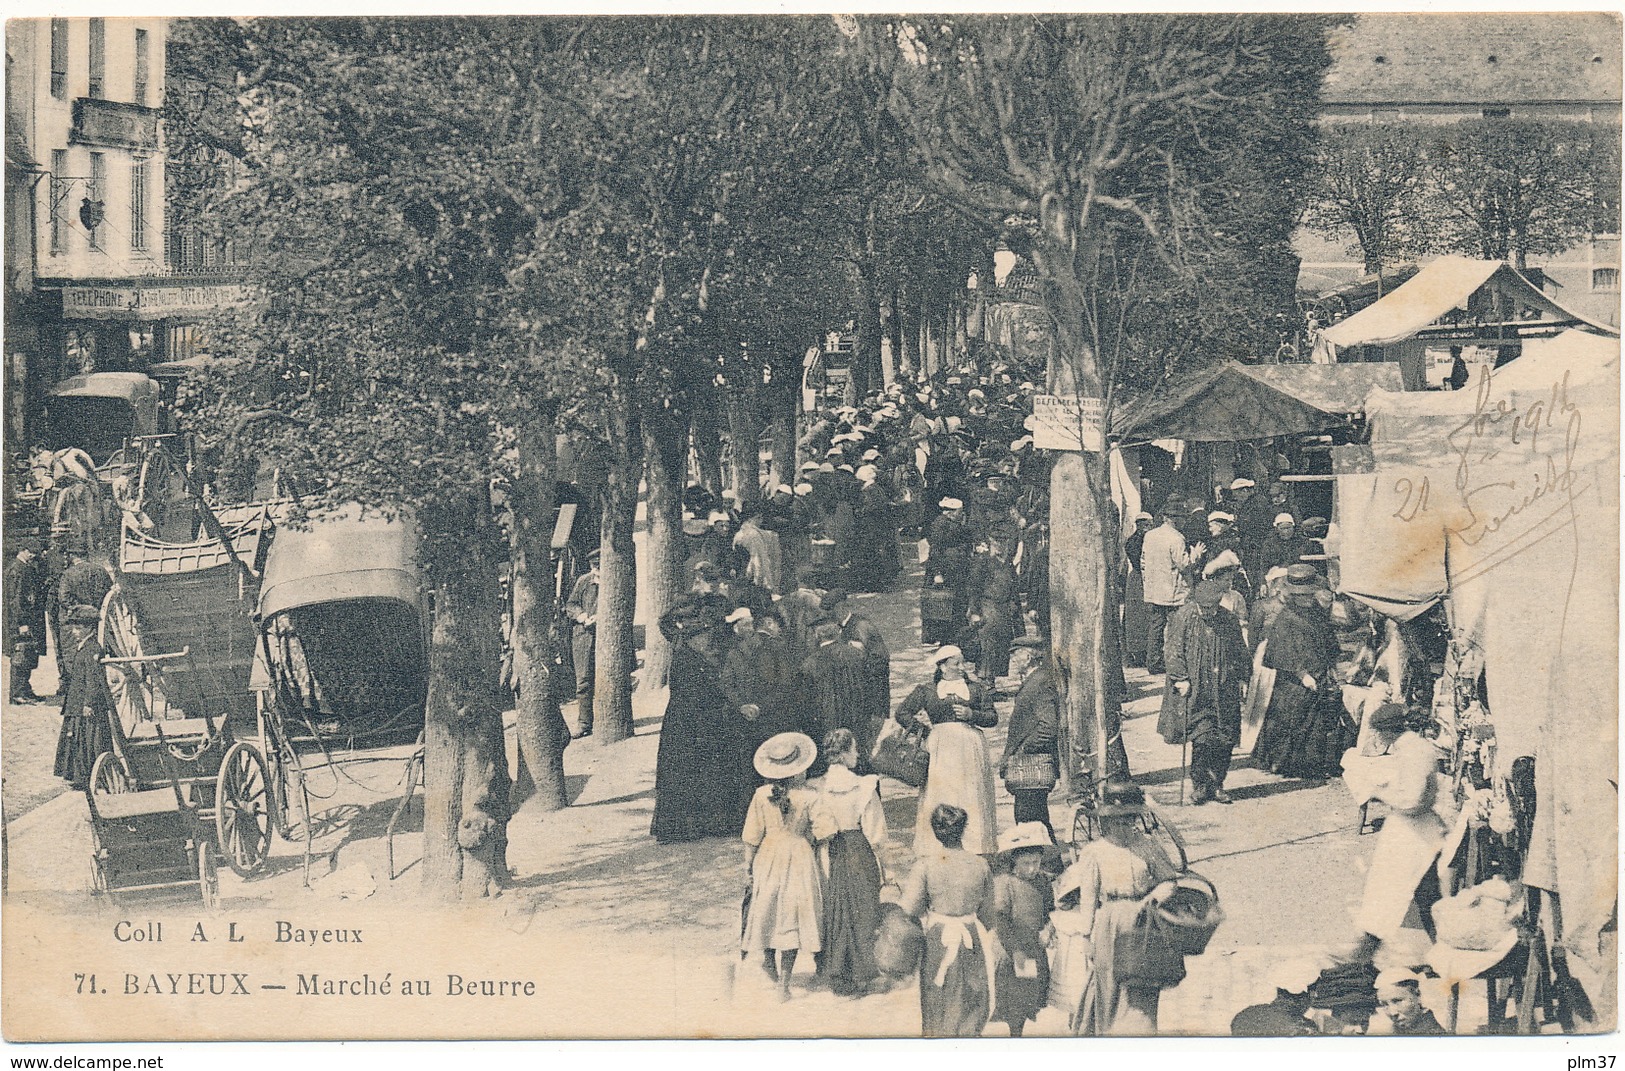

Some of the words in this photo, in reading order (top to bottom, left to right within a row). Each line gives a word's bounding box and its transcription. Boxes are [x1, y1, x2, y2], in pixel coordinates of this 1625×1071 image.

[1393, 475, 1430, 523] 21
[113, 920, 163, 942] Coll
[228, 922, 244, 942] L
[274, 920, 364, 946] Bayeux
[74, 972, 107, 995] 71.
[123, 973, 251, 995] BAYEUX
[295, 972, 392, 996] Marché
[401, 980, 432, 996] au
[446, 974, 536, 997] Beurre
